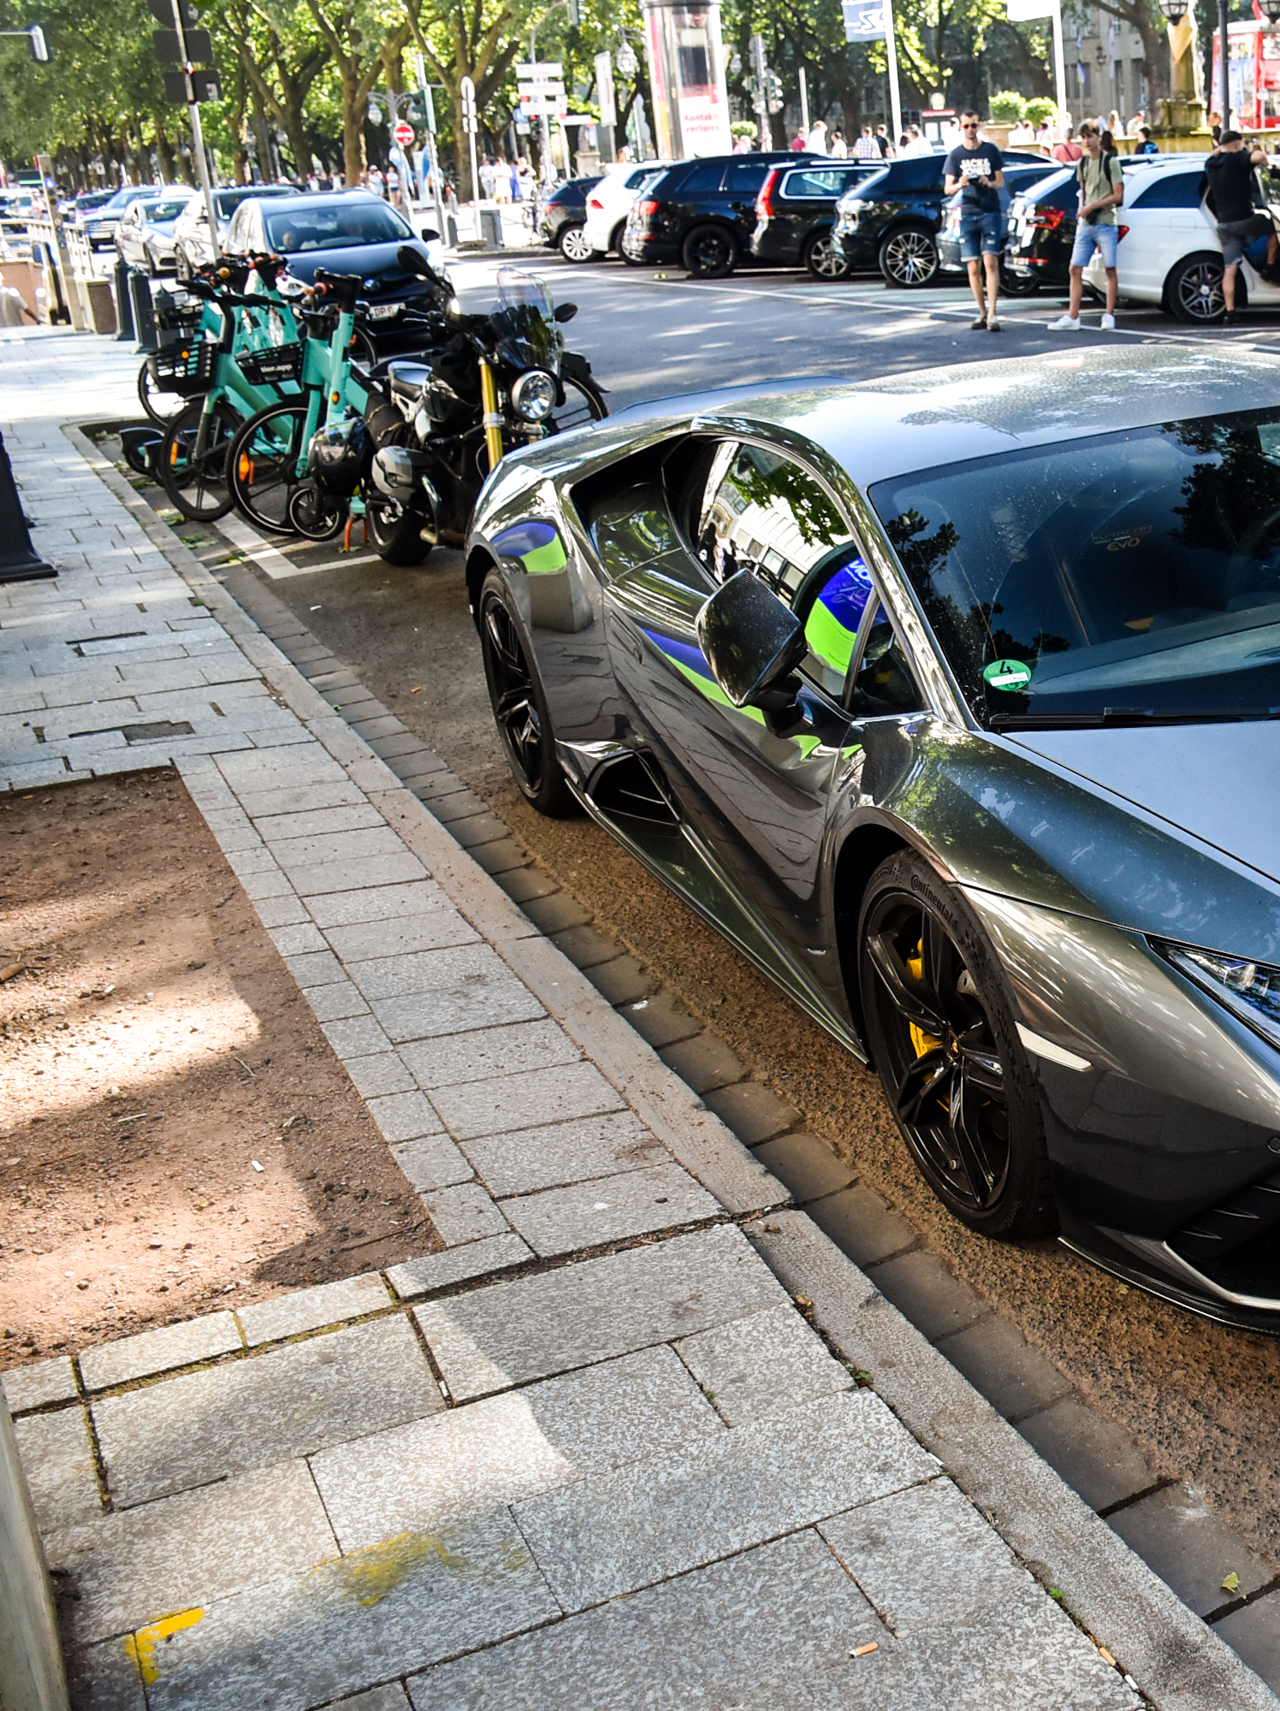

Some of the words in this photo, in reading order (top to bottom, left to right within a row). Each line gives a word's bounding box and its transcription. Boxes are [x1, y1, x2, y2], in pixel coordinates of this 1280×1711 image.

[1107, 537, 1140, 551] EVO
[999, 660, 1014, 675] 4
[910, 874, 955, 924] Continental
